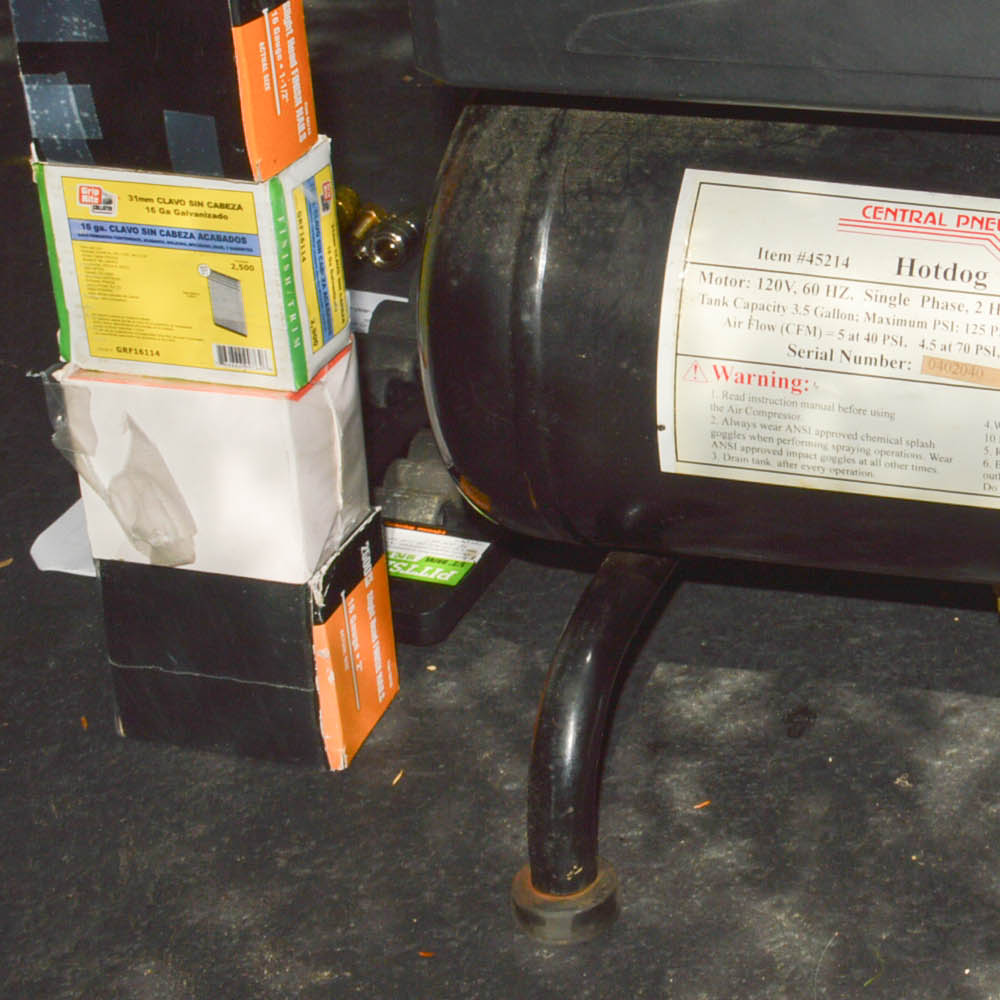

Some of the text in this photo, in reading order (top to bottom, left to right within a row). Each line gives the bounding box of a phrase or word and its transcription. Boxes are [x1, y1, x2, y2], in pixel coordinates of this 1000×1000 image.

[156, 196, 186, 207] CLAVO
[188, 199, 204, 209] SIN
[206, 201, 243, 212] CABEZA
[174, 209, 229, 221] Galvanizado
[861, 204, 948, 227] CENTRAL
[109, 224, 139, 235] CLAVO
[141, 227, 157, 237] SIN
[159, 229, 196, 240] CABEZA
[197, 232, 248, 245] ACABADOS
[231, 263, 255, 272] 2,500
[757, 246, 850, 268] Item #45214
[895, 255, 991, 289] Hotdog
[700, 271, 751, 290] Motor:
[802, 282, 820, 297] 60
[863, 288, 910, 309] Single
[975, 300, 982, 315] 2
[699, 292, 728, 308] Tank
[733, 296, 786, 316] Capacity
[791, 303, 810, 317] 3.5
[863, 310, 927, 330] Maximum
[964, 322, 989, 336] 125
[725, 316, 744, 329] Air
[747, 317, 776, 332] Flow
[847, 330, 860, 341] at
[863, 331, 877, 343] 40
[917, 337, 936, 350] 4.5
[939, 340, 953, 352] at
[956, 341, 970, 354] 70
[786, 342, 834, 362] Serial
[839, 348, 912, 370] Number:
[712, 364, 810, 393] Warning:
[710, 402, 724, 414] the
[727, 404, 743, 416] Air
[721, 389, 745, 402] Read
[747, 392, 797, 407] instruction
[800, 398, 834, 411] manual
[838, 402, 867, 415] before
[870, 406, 895, 421] using
[710, 428, 745, 443] goggles
[749, 432, 774, 444] when
[776, 435, 828, 453] performing
[831, 441, 870, 457] spraying
[929, 452, 952, 464] Wear
[721, 415, 935, 451] Always wear ANSI approved chemical splash
[984, 433, 996, 443] 10
[711, 440, 737, 453] ANSI
[740, 443, 783, 460] approved
[786, 448, 817, 464] impact
[819, 452, 856, 469] goggles
[858, 457, 868, 467] at
[869, 457, 881, 469] all
[883, 458, 907, 471] other
[721, 452, 749, 465] Drain
[776, 457, 798, 470] after
[800, 462, 825, 476] every
[983, 482, 996, 492] Do
